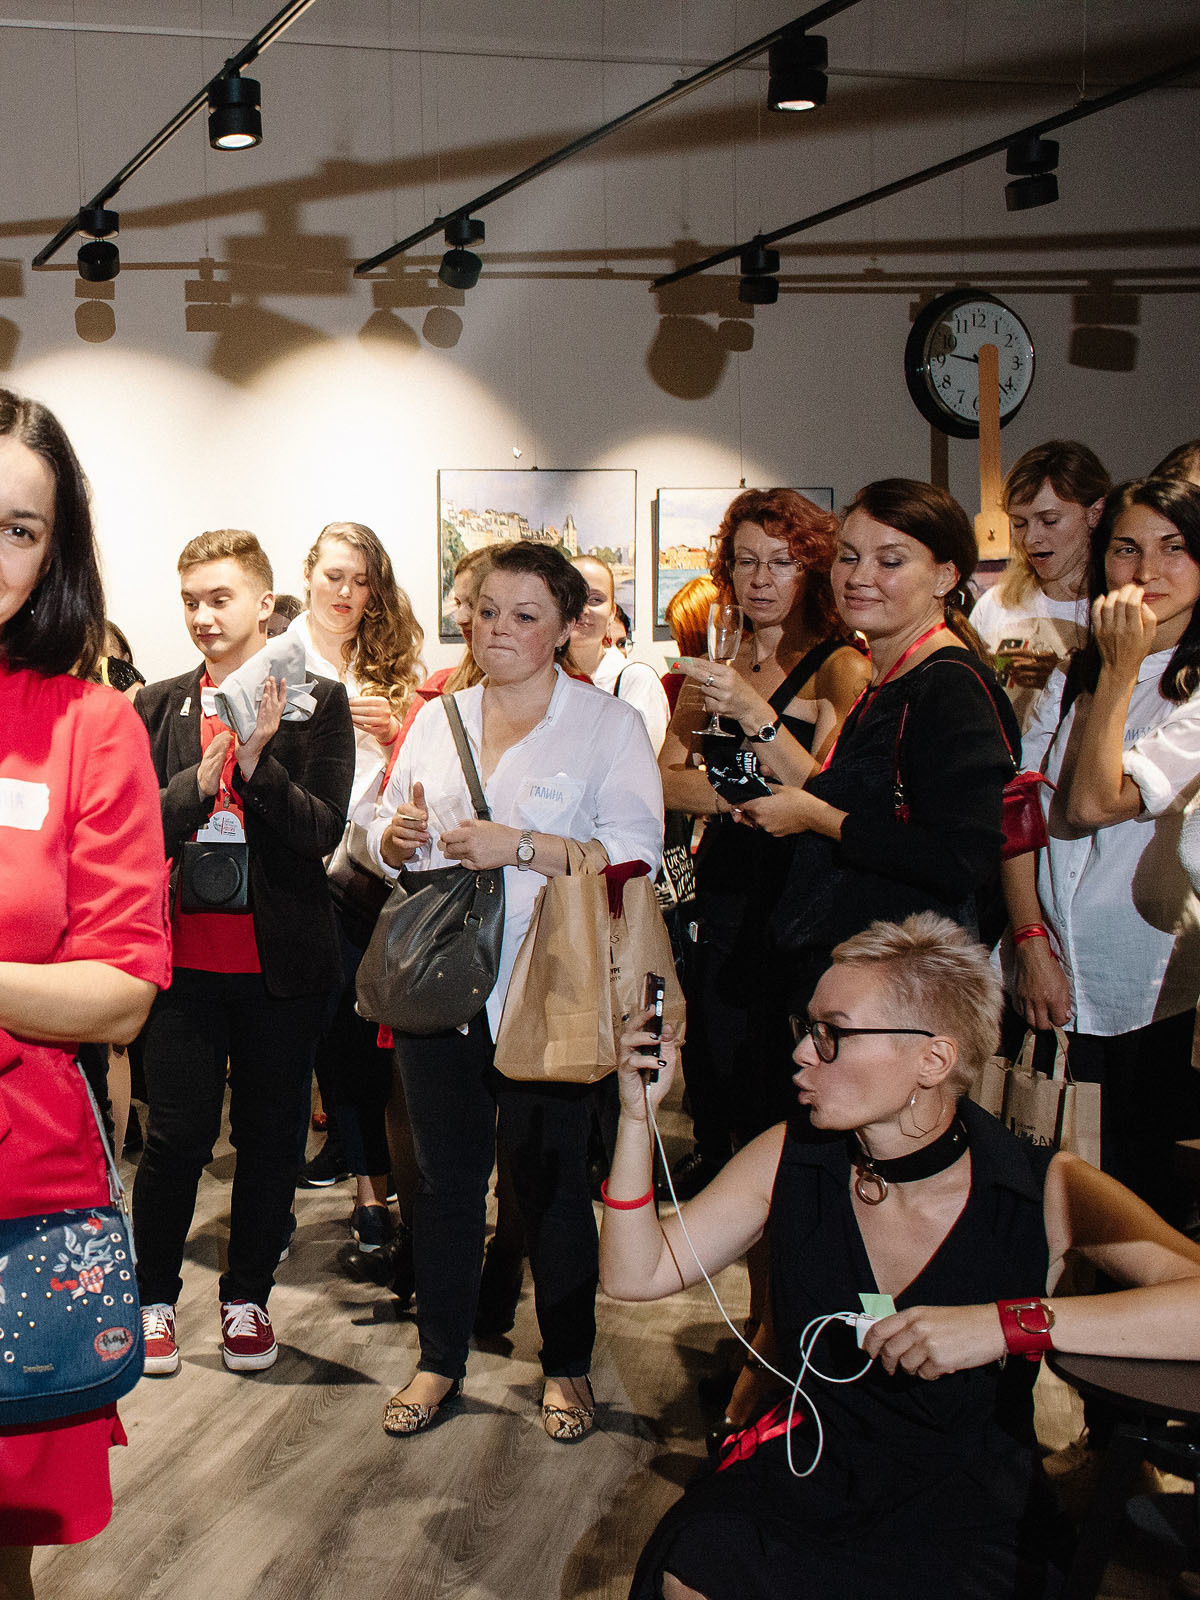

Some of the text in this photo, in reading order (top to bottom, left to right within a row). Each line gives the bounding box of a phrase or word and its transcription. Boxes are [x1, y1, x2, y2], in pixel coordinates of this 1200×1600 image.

[957, 318, 968, 333] 11
[972, 313, 986, 328] 12
[943, 334, 958, 349] 10
[1005, 333, 1013, 348] 2
[936, 353, 946, 368] 9
[1012, 356, 1020, 371] 3
[942, 375, 951, 389] 8
[1005, 376, 1013, 390] 4
[957, 390, 965, 404] 7
